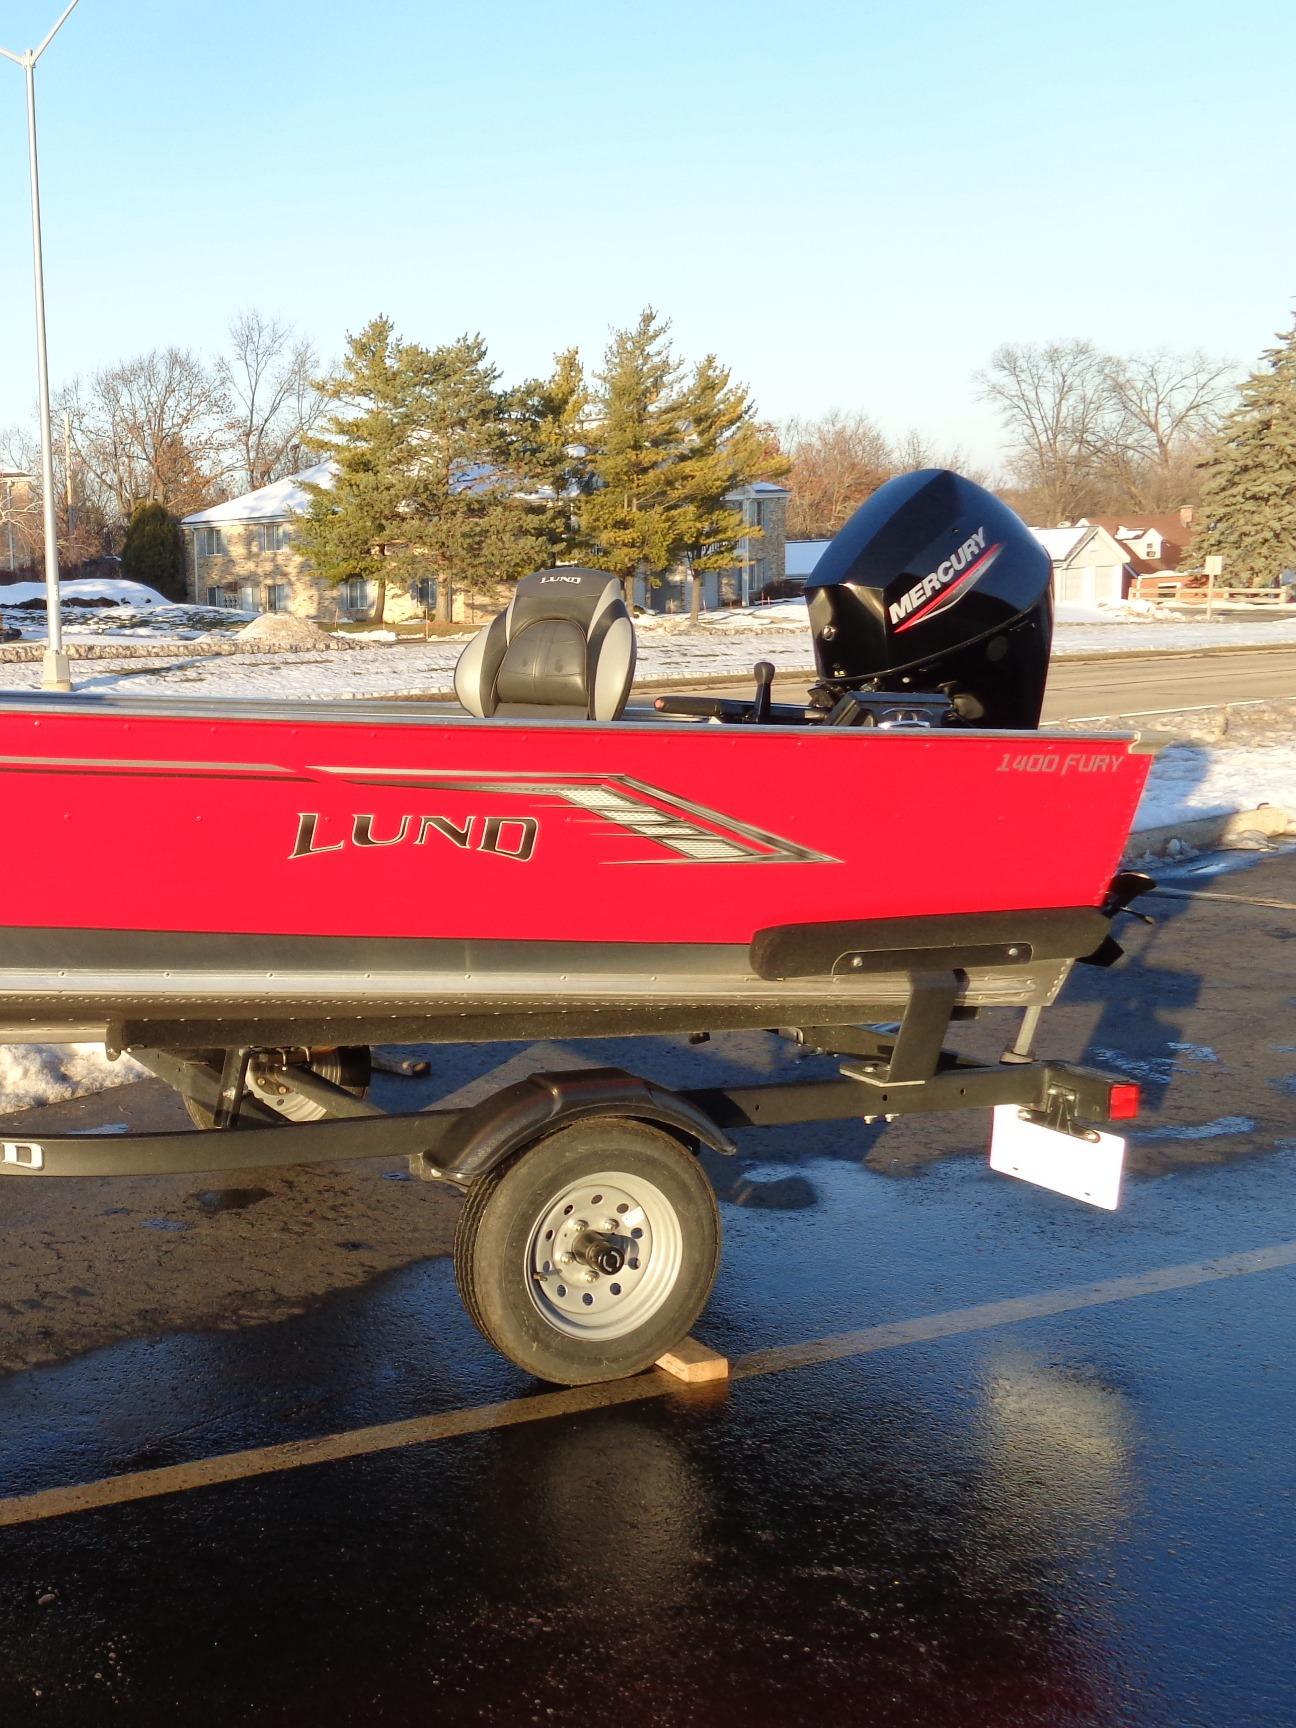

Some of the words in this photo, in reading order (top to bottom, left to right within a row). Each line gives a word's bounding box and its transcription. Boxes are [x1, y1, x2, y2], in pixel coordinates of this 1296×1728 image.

[539, 576, 582, 585] LUND
[888, 526, 986, 625] MERCURY
[996, 753, 1059, 773] 1400
[1060, 753, 1125, 776] FURY
[287, 812, 539, 862] LUND
